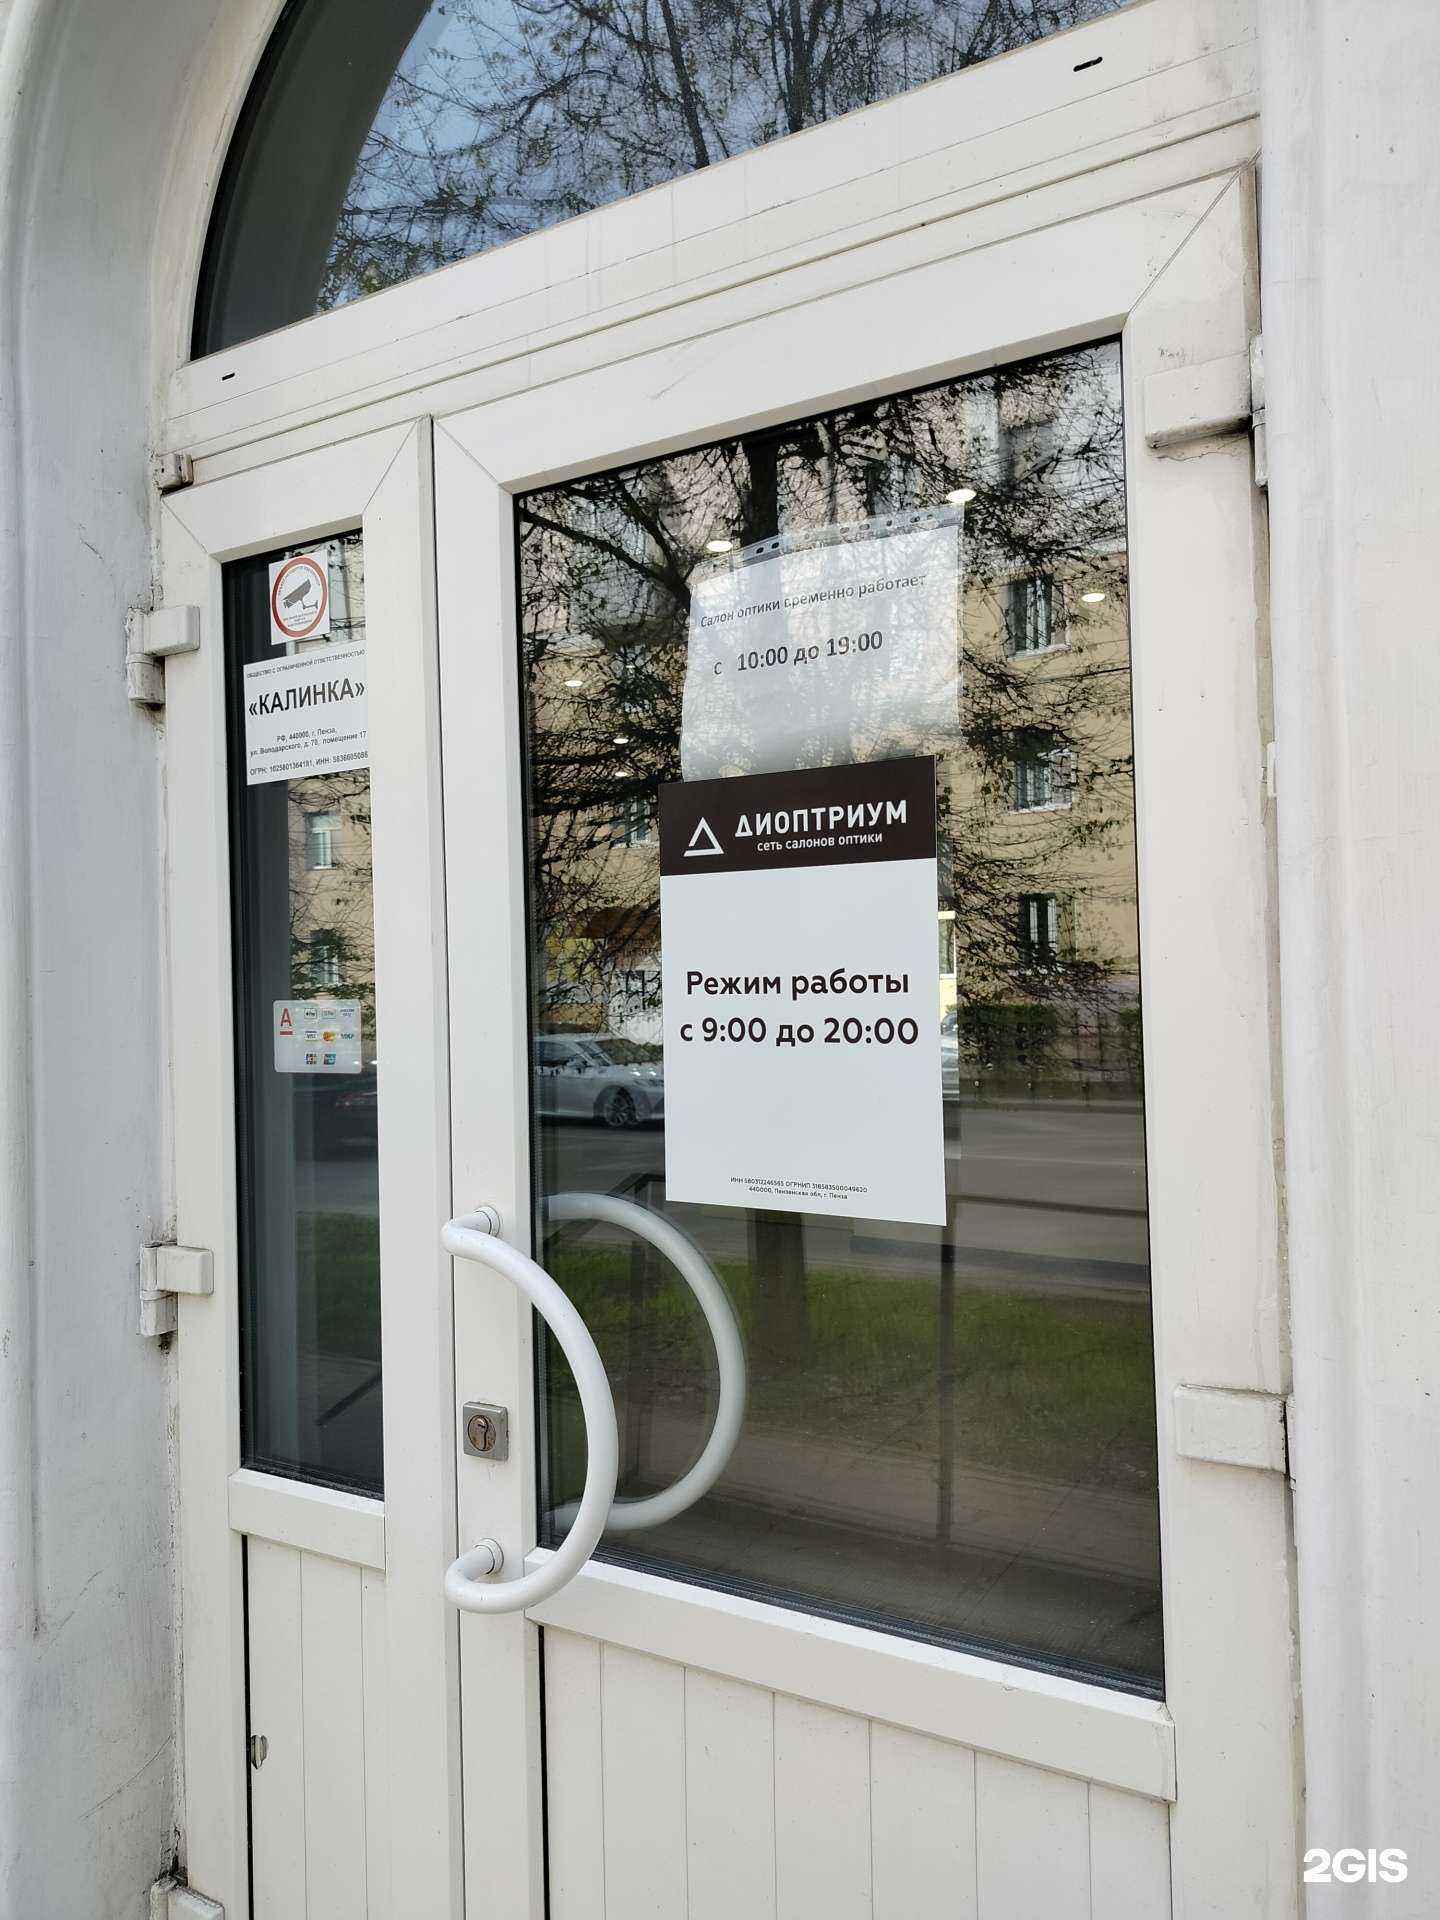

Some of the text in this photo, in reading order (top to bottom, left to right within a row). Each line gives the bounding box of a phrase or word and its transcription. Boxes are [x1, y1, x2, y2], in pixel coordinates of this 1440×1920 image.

[701, 611, 734, 627] Салон
[737, 600, 780, 619] оптики
[738, 646, 788, 671] 10:00
[794, 643, 819, 665] до
[826, 631, 883, 656] 19:00
[249, 678, 365, 715] «КАЛИНКА»
[323, 734, 358, 745] помещение
[360, 731, 367, 739] 17
[316, 757, 331, 766] ИНН:
[735, 800, 907, 838] ДИОПТРИУМ
[757, 832, 883, 851] сеть салонов оптики
[687, 968, 909, 1001] Режим работы
[680, 1017, 919, 1046] с 9:00 до 20:00
[786, 1181, 811, 1189] ОГРНИП
[829, 1192, 848, 1200] Пенза
